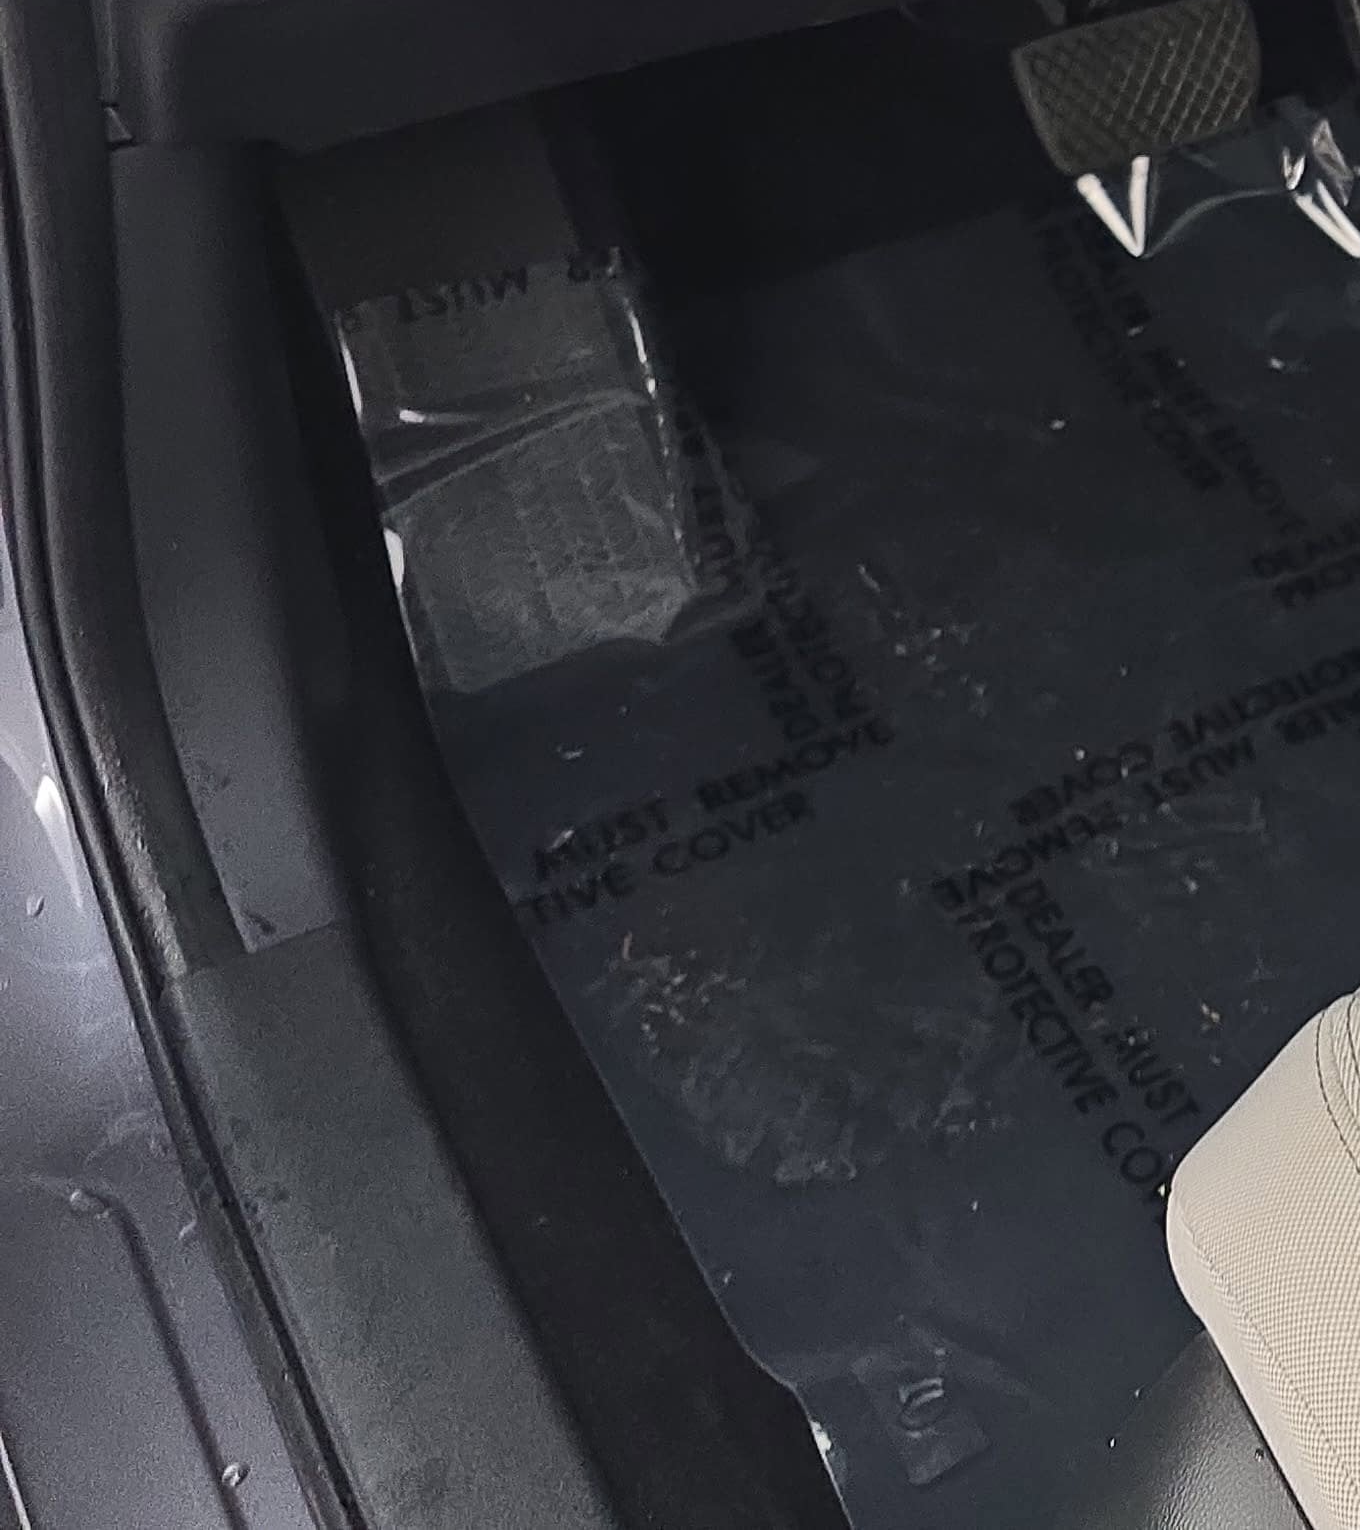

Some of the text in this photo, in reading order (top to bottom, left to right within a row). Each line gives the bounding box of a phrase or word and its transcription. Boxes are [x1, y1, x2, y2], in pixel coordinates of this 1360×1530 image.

[694, 717, 896, 813] REMOVE
[654, 790, 811, 876] COVER
[1006, 878, 1115, 1011] DEALER
